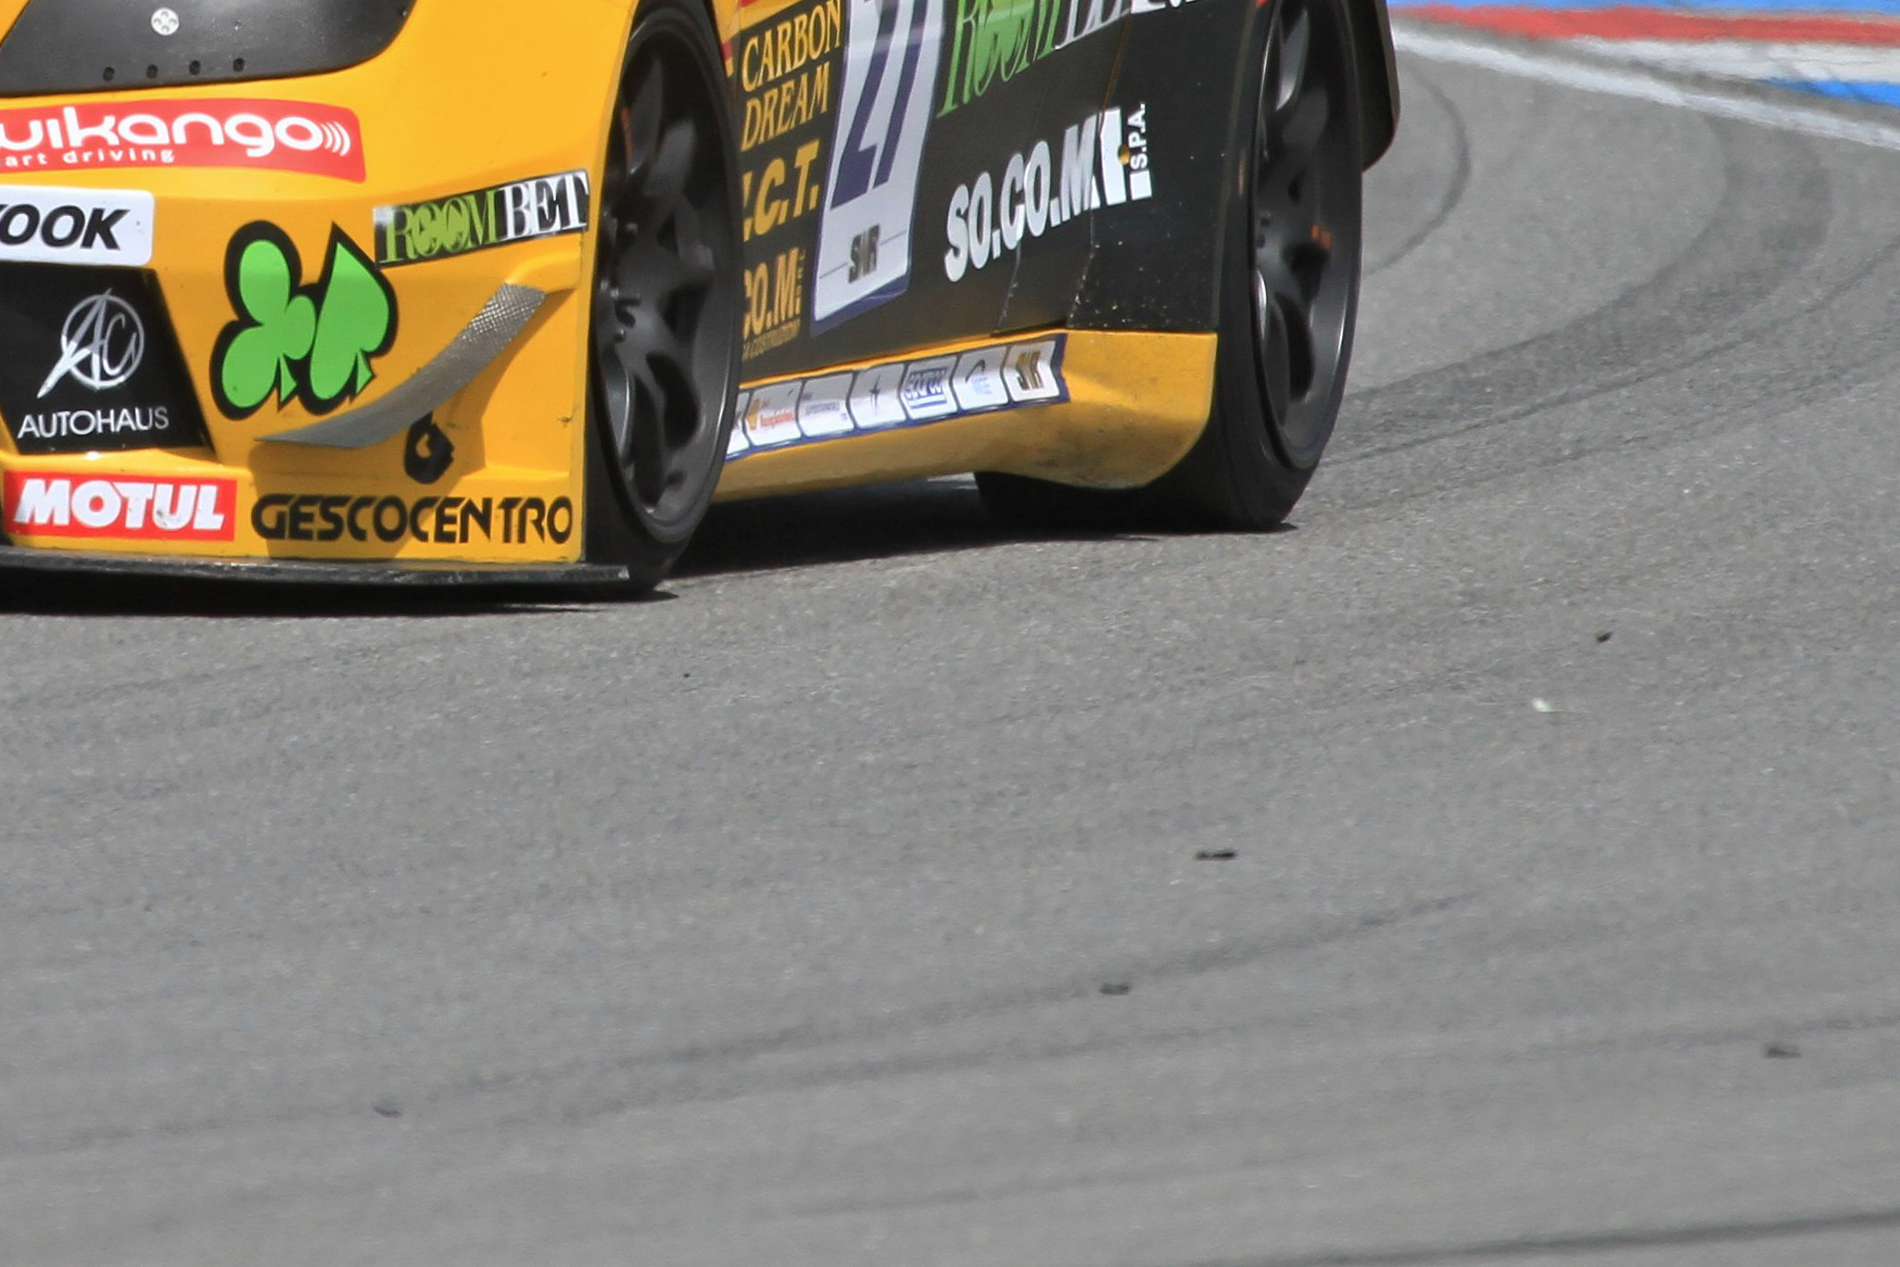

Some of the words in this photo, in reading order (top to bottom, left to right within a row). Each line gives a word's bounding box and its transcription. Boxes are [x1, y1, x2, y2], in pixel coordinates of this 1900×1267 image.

[741, 61, 830, 152] DREAM
[62, 147, 175, 164] driving
[17, 406, 170, 439] AUTOHAUS
[14, 478, 227, 532] MOTUL
[251, 493, 574, 545] GESCOCENTRO
